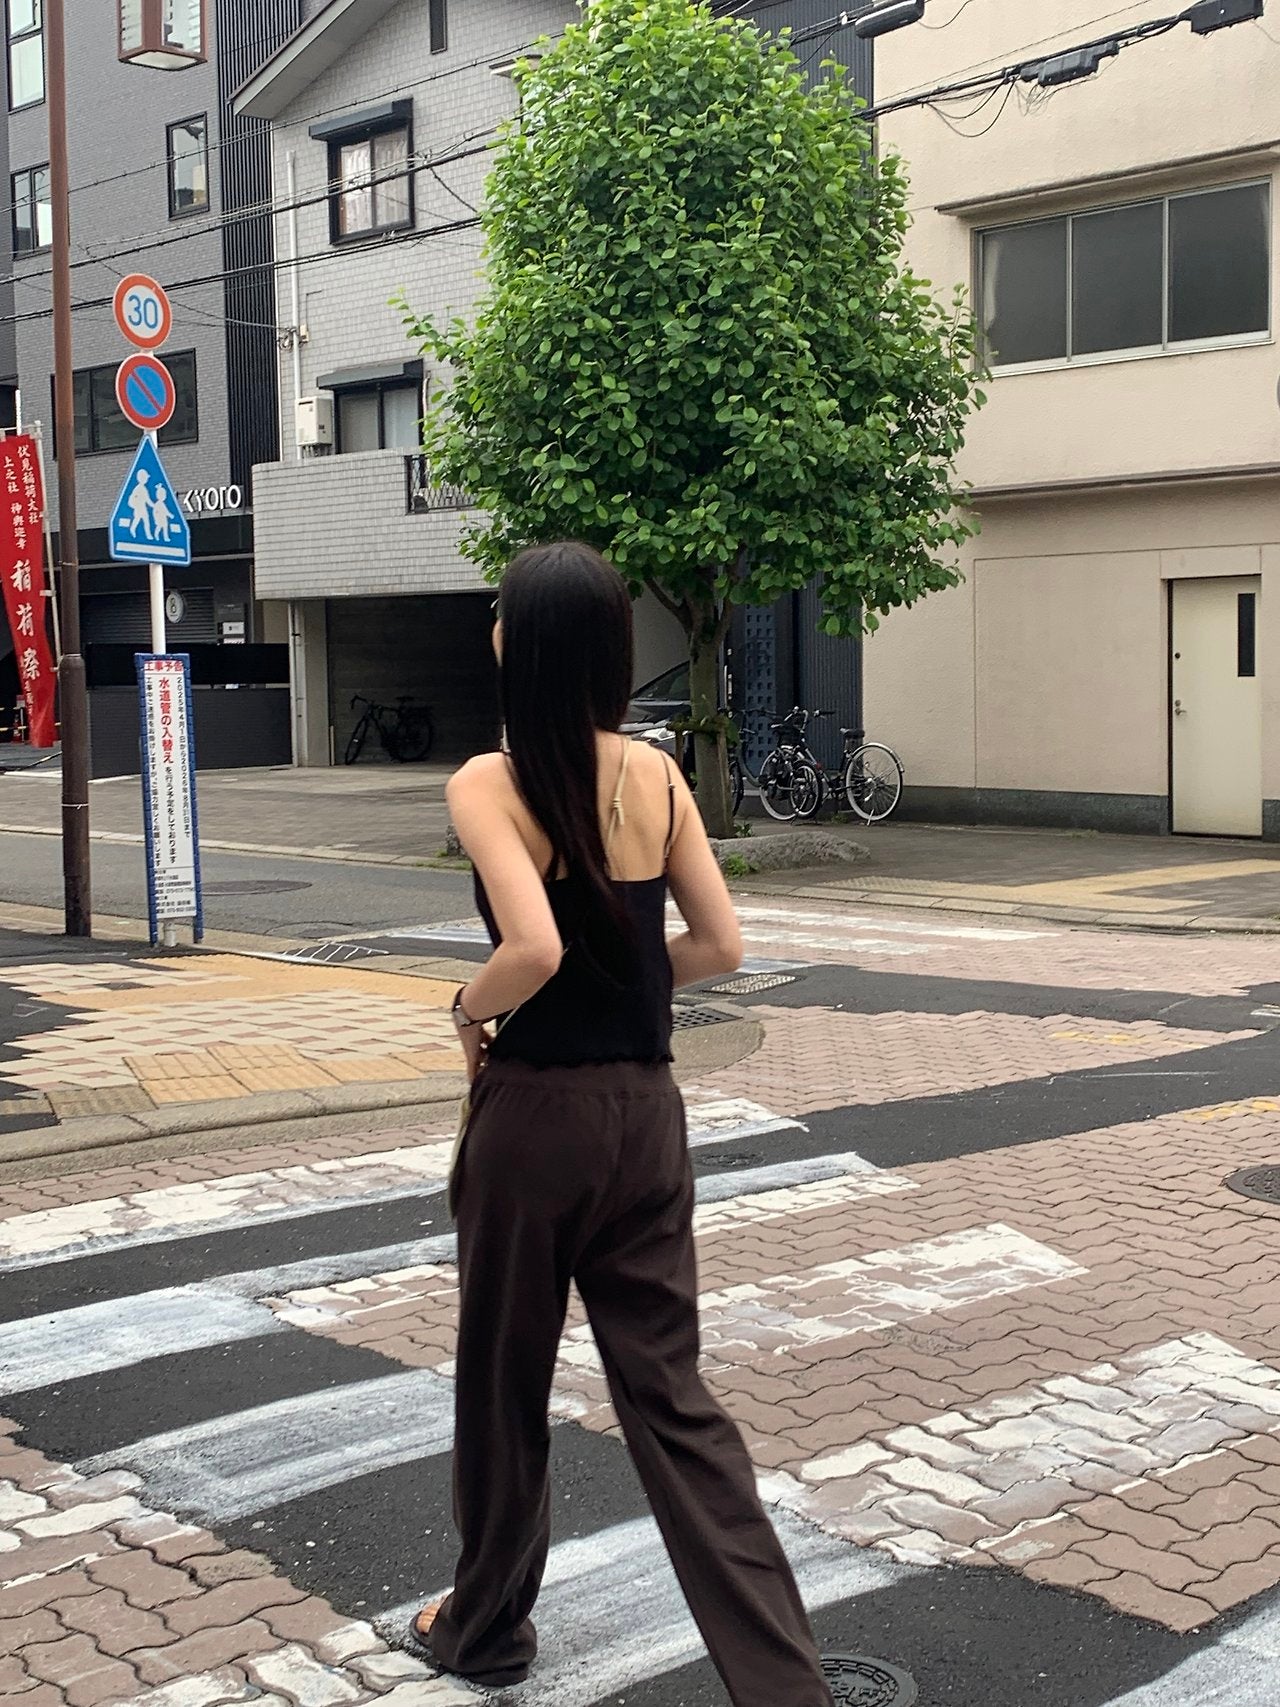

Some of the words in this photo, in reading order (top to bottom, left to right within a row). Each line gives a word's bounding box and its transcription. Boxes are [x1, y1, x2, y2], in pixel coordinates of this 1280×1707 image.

[128, 294, 158, 329] 30
[17, 444, 39, 525] 伏見稲荷大社
[10, 559, 40, 681] 稲荷祭
[144, 661, 184, 672] 工事予告
